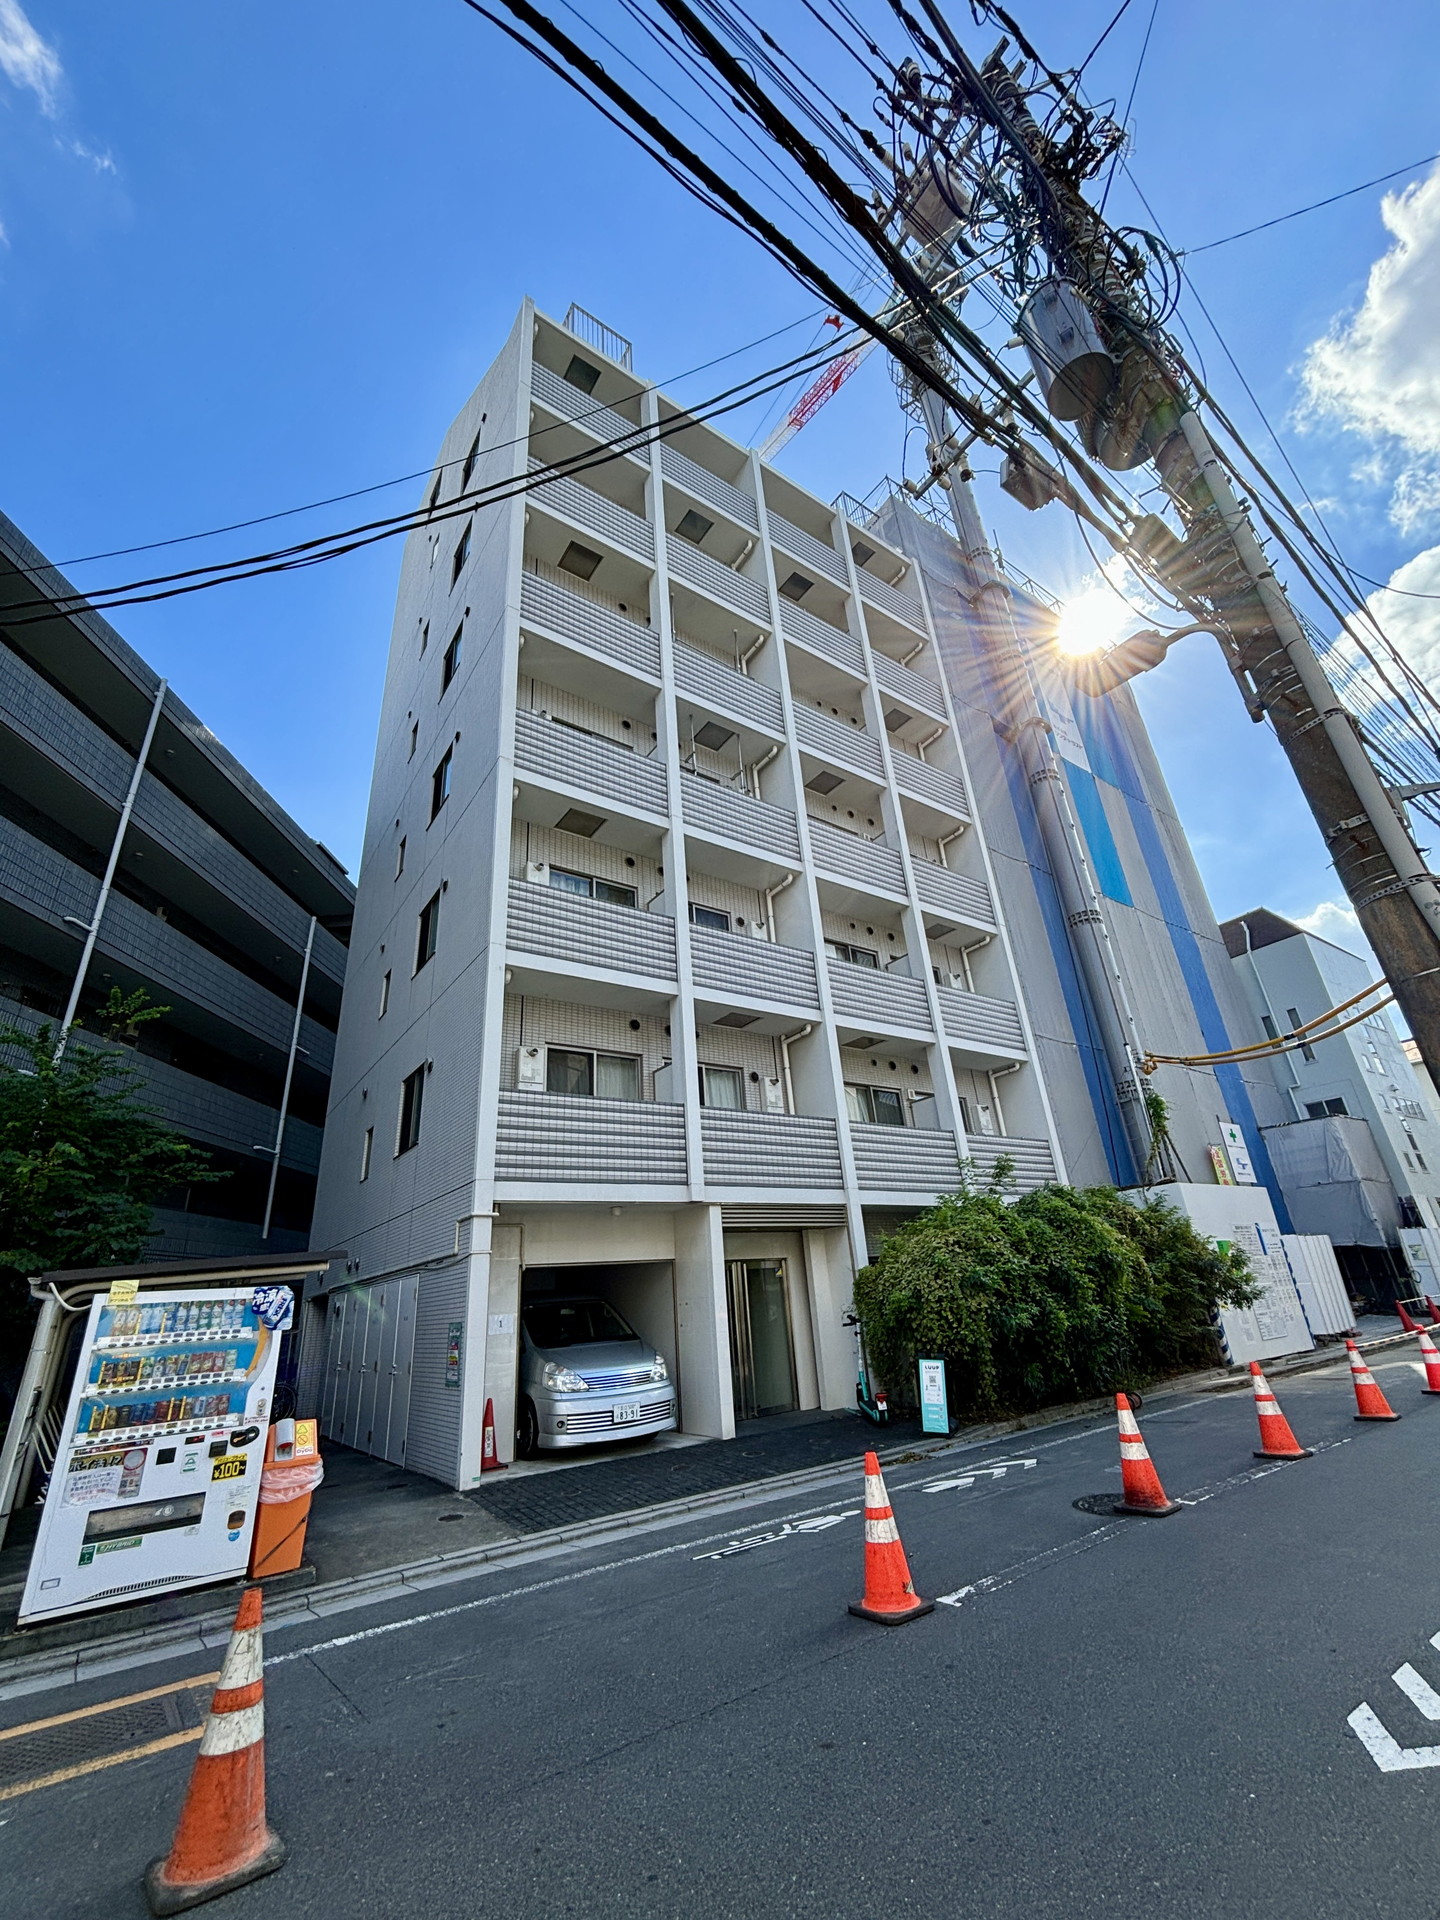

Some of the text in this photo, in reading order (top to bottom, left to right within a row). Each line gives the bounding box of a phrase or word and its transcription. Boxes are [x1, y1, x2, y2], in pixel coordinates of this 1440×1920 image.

[499, 1320, 503, 1328] 1
[620, 1409, 638, 1420] 83-91
[296, 1447, 313, 1455] DyDo
